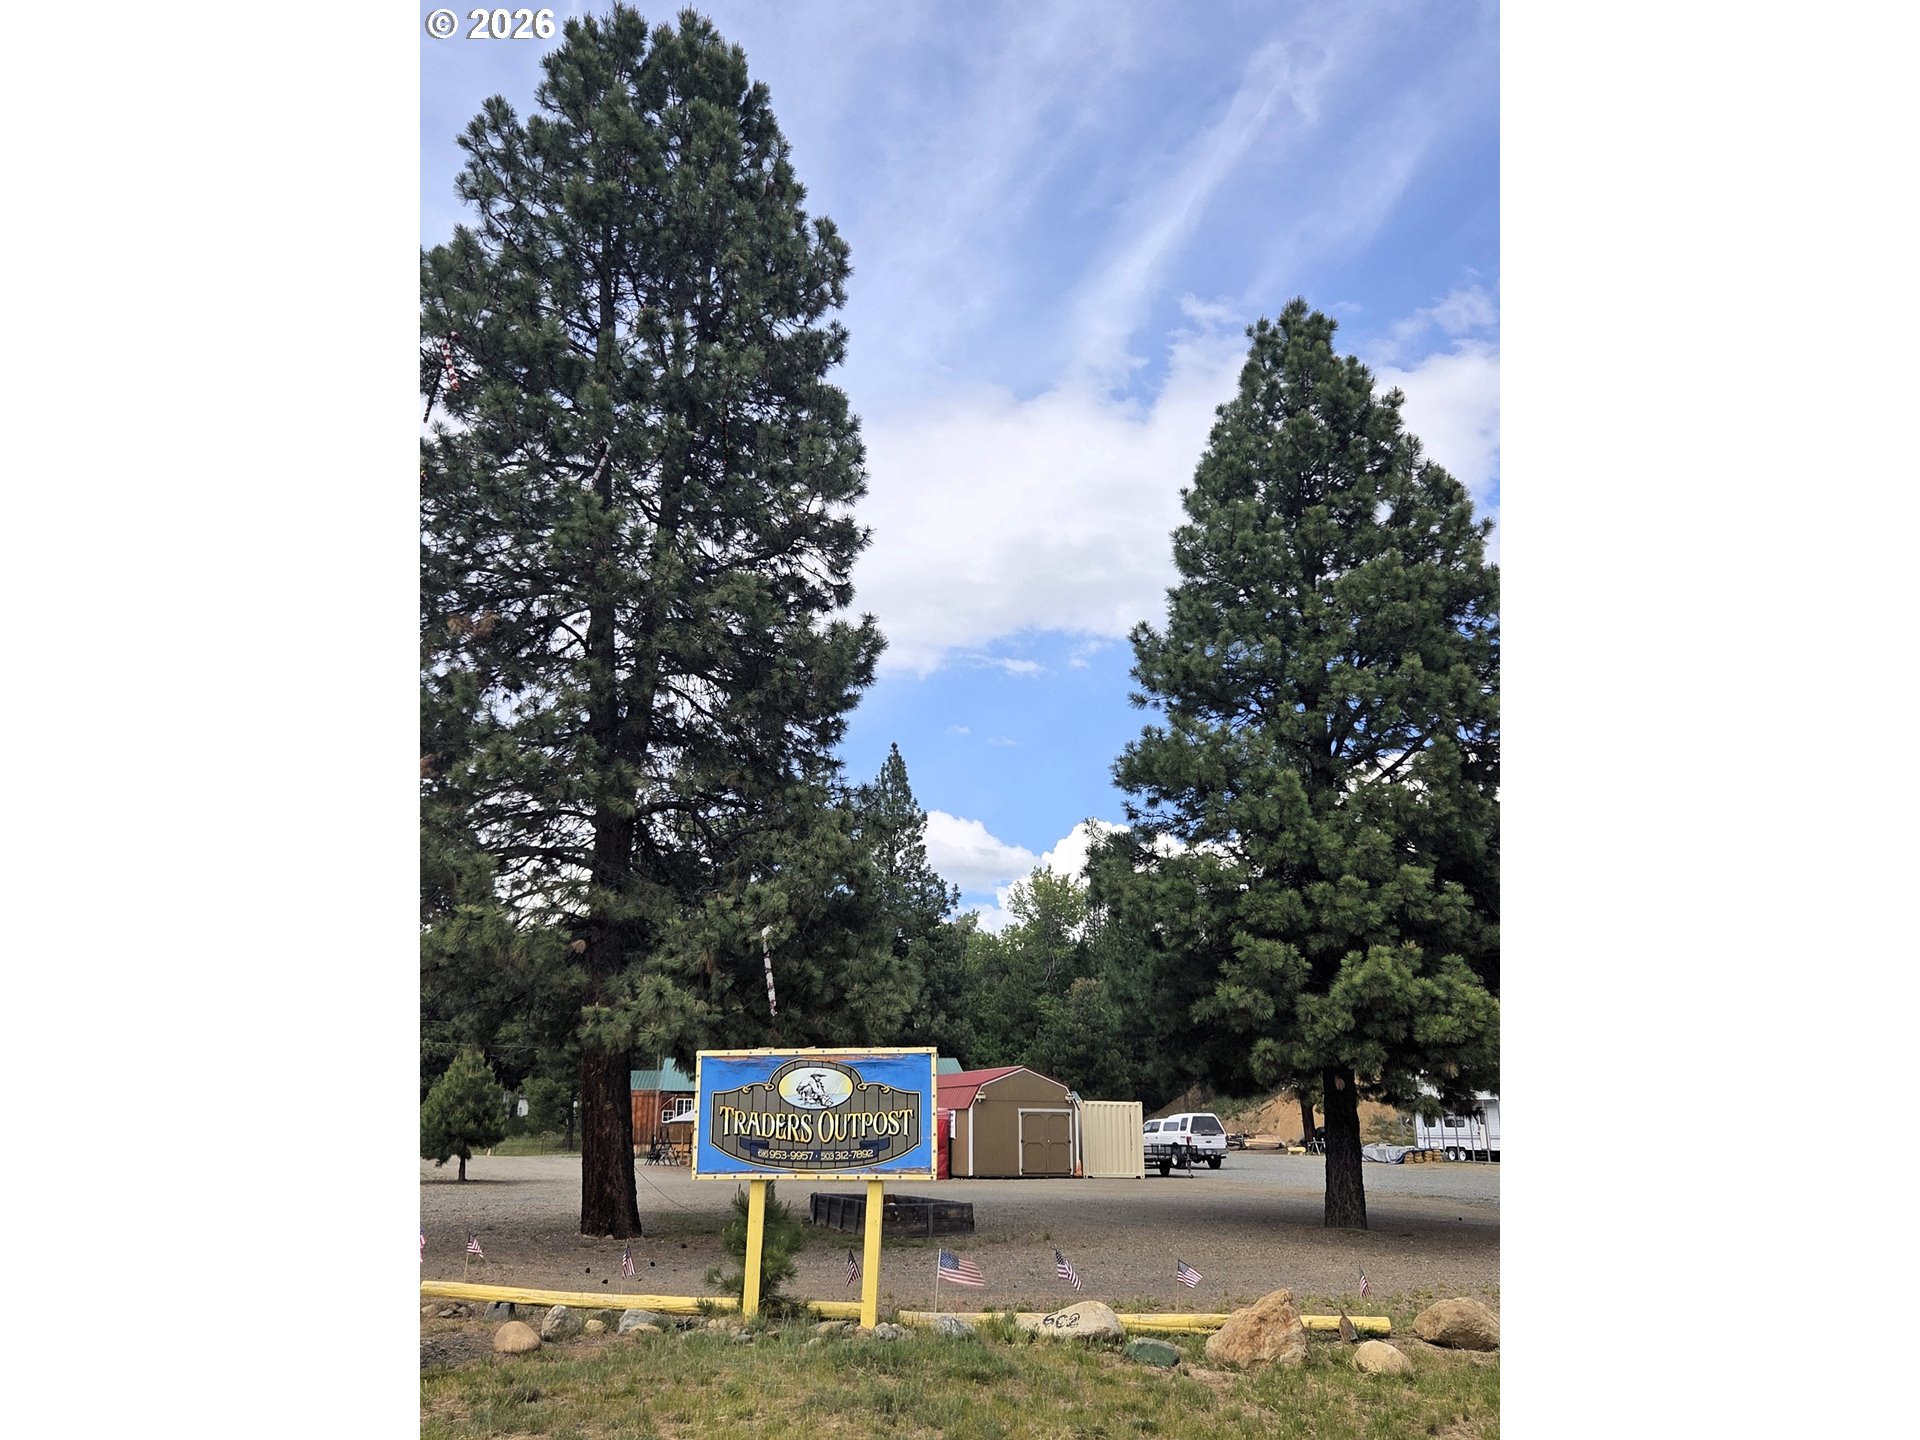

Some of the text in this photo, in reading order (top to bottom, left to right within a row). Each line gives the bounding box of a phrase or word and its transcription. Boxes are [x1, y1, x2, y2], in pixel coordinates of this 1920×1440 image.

[719, 1106, 813, 1144] TRADERS
[818, 1108, 914, 1144] OUTPOST
[1042, 1311, 1081, 1329] 602
